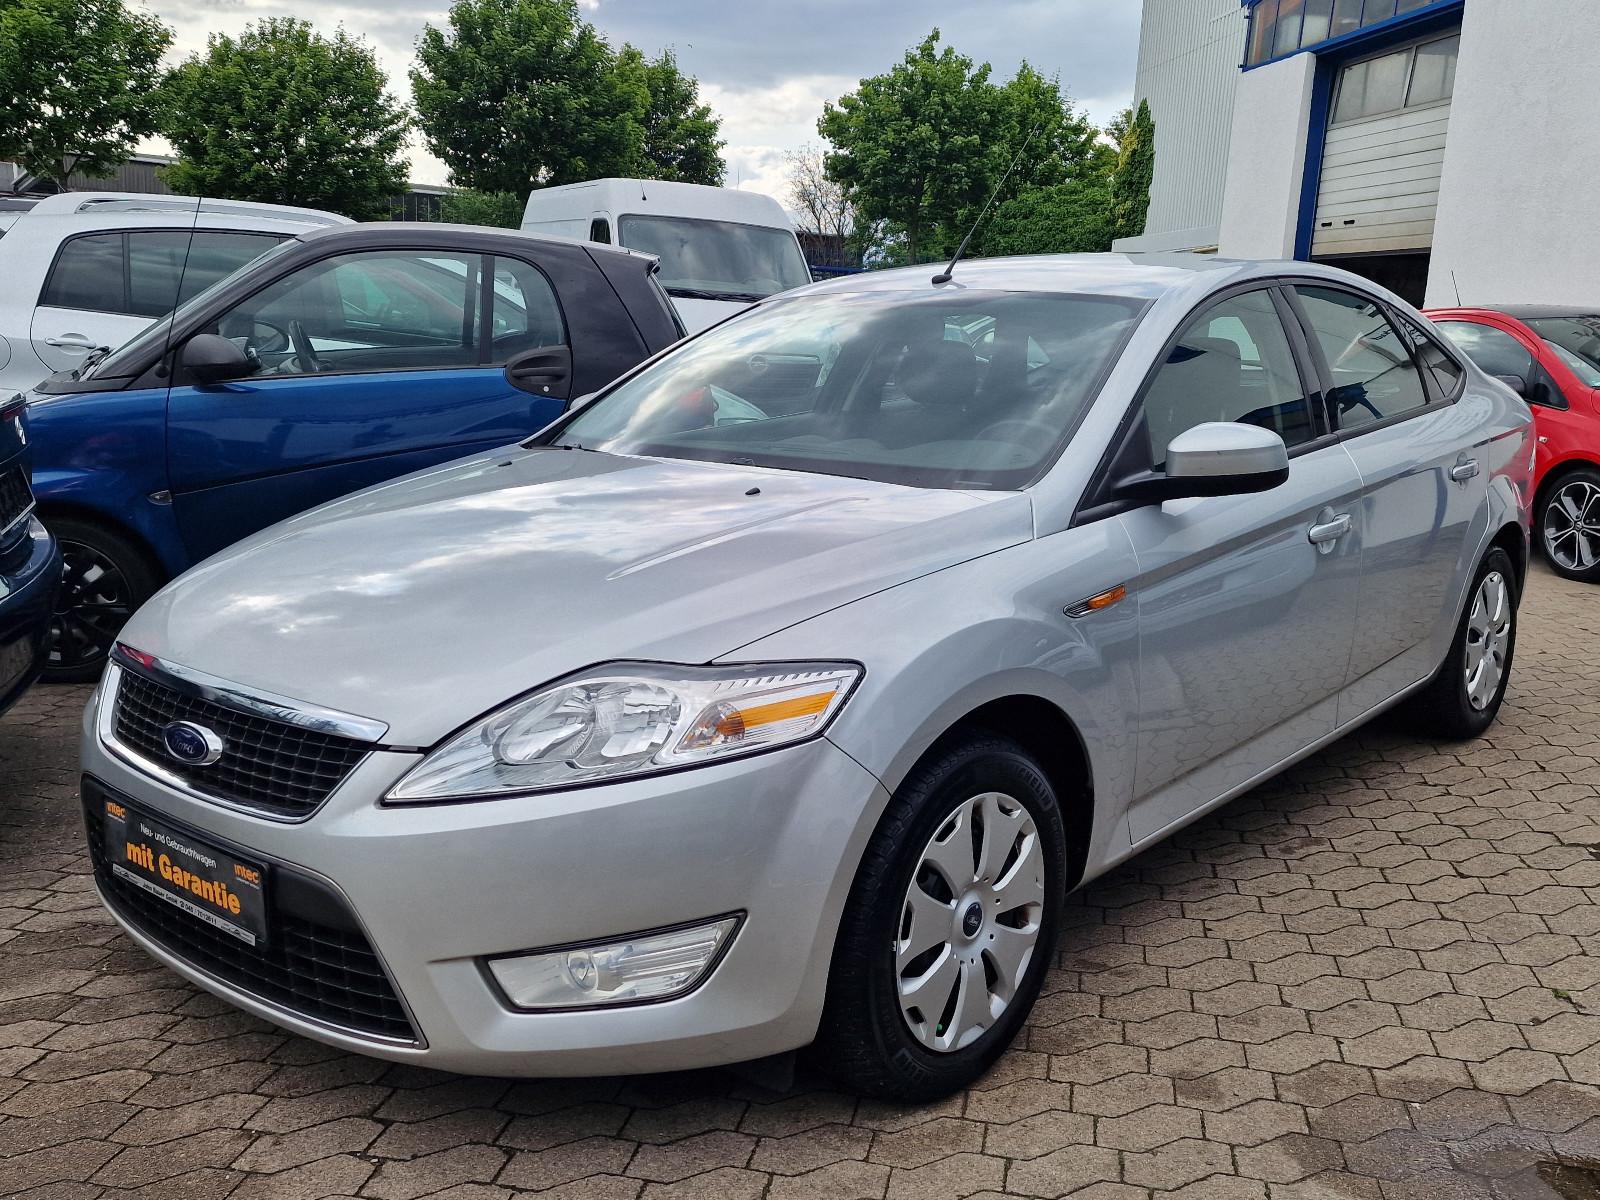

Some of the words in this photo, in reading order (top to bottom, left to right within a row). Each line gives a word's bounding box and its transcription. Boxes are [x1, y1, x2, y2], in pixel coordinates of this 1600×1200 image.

[154, 832, 166, 845] und
[166, 835, 216, 869] Gebrauchtwagen
[127, 842, 154, 872] mit
[159, 853, 241, 915] Garantie
